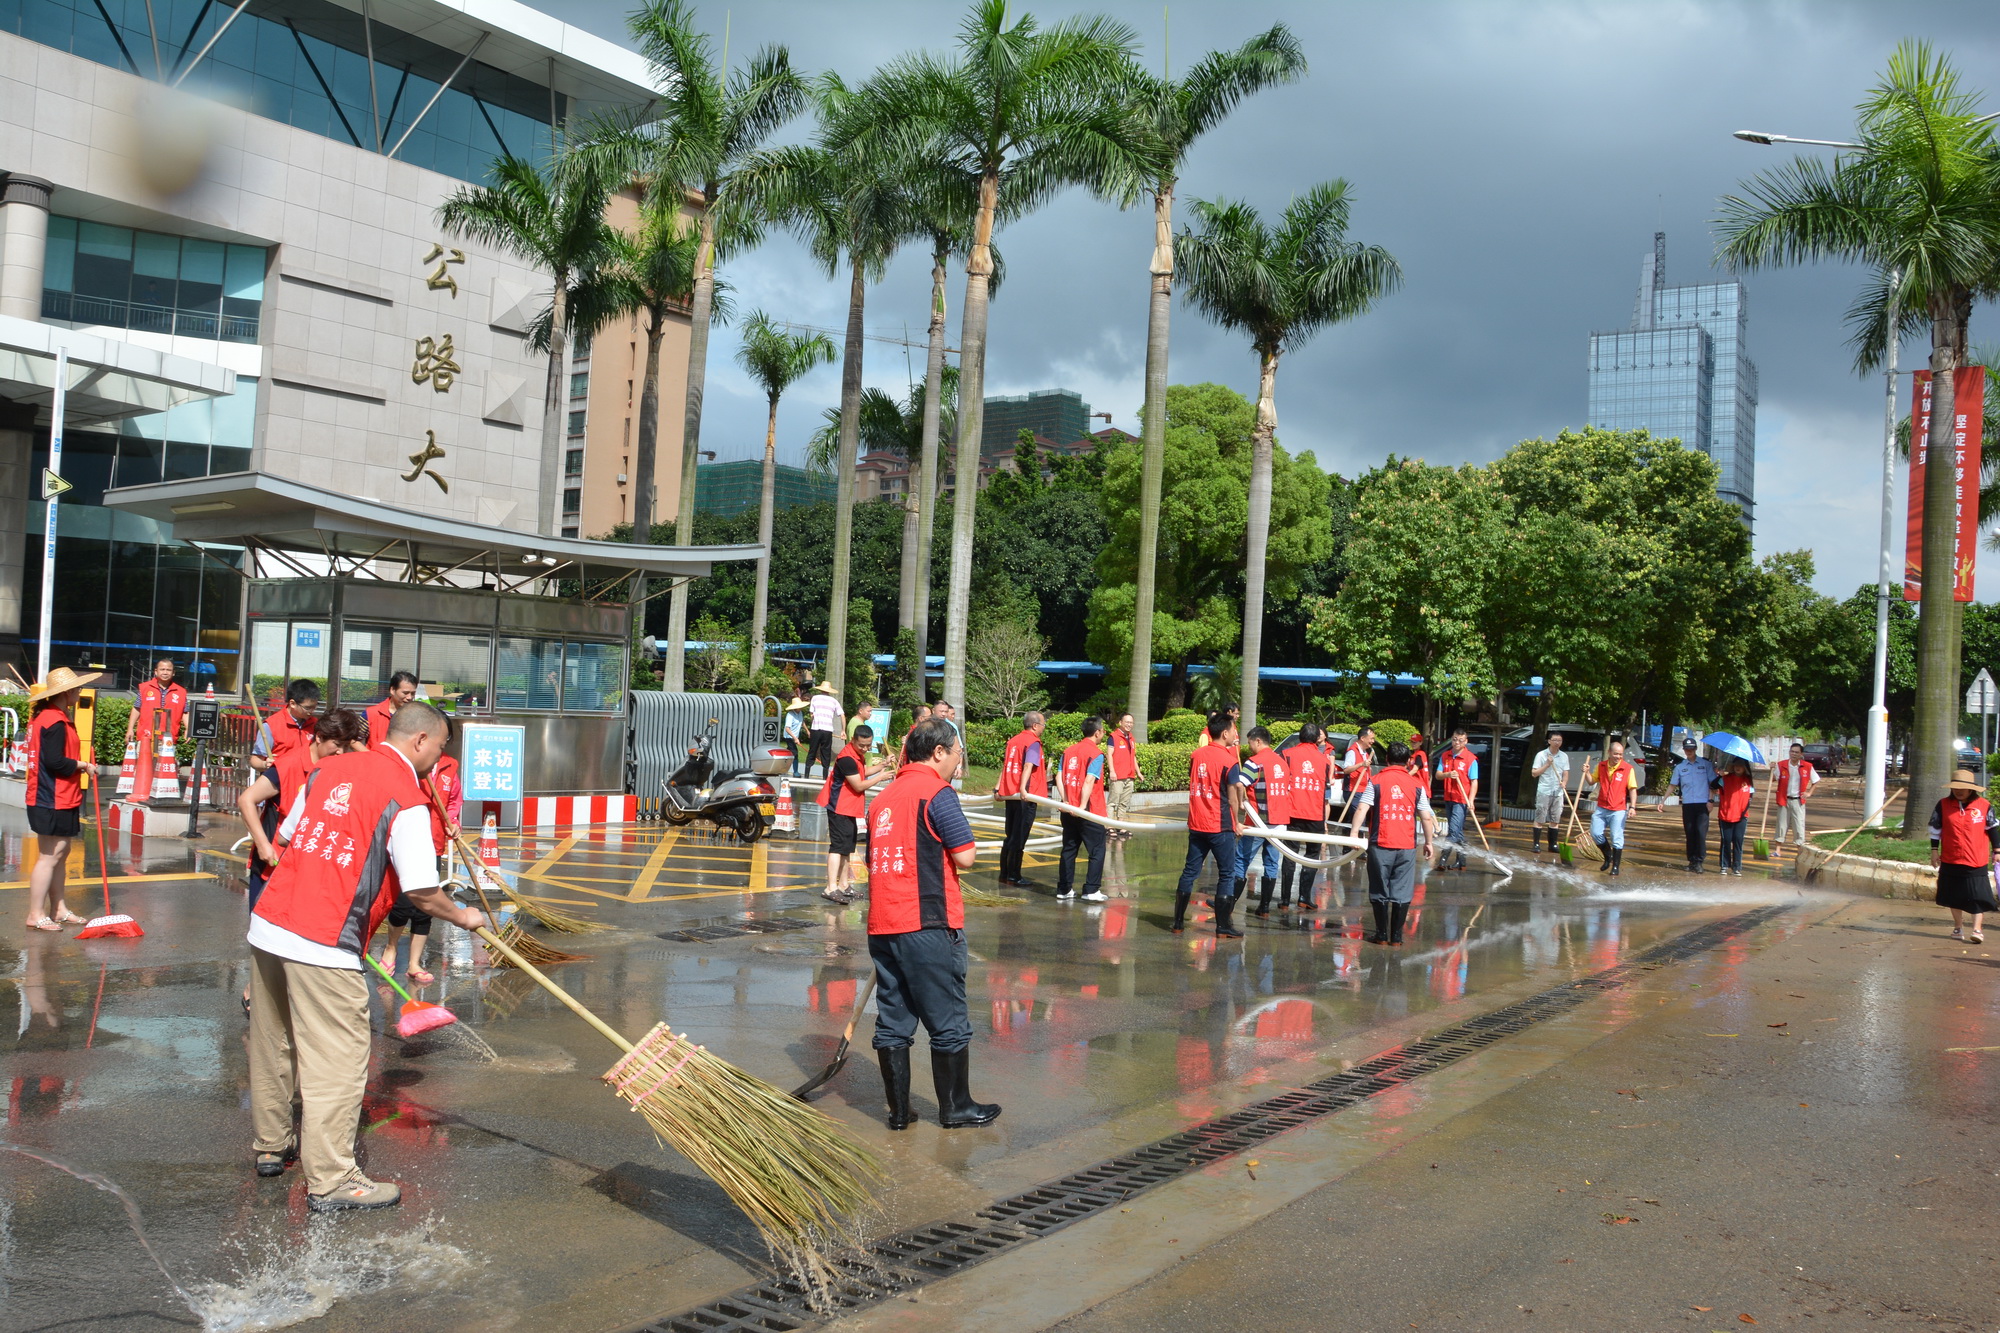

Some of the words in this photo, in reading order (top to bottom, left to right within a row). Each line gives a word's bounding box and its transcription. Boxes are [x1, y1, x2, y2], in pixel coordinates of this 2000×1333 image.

[162, 763, 177, 772] 注意
[473, 747, 514, 768] 来访
[472, 771, 514, 791] 登记
[297, 816, 355, 851] 党员义工
[293, 834, 353, 869] 服务先锋
[482, 847, 499, 859] 注意
